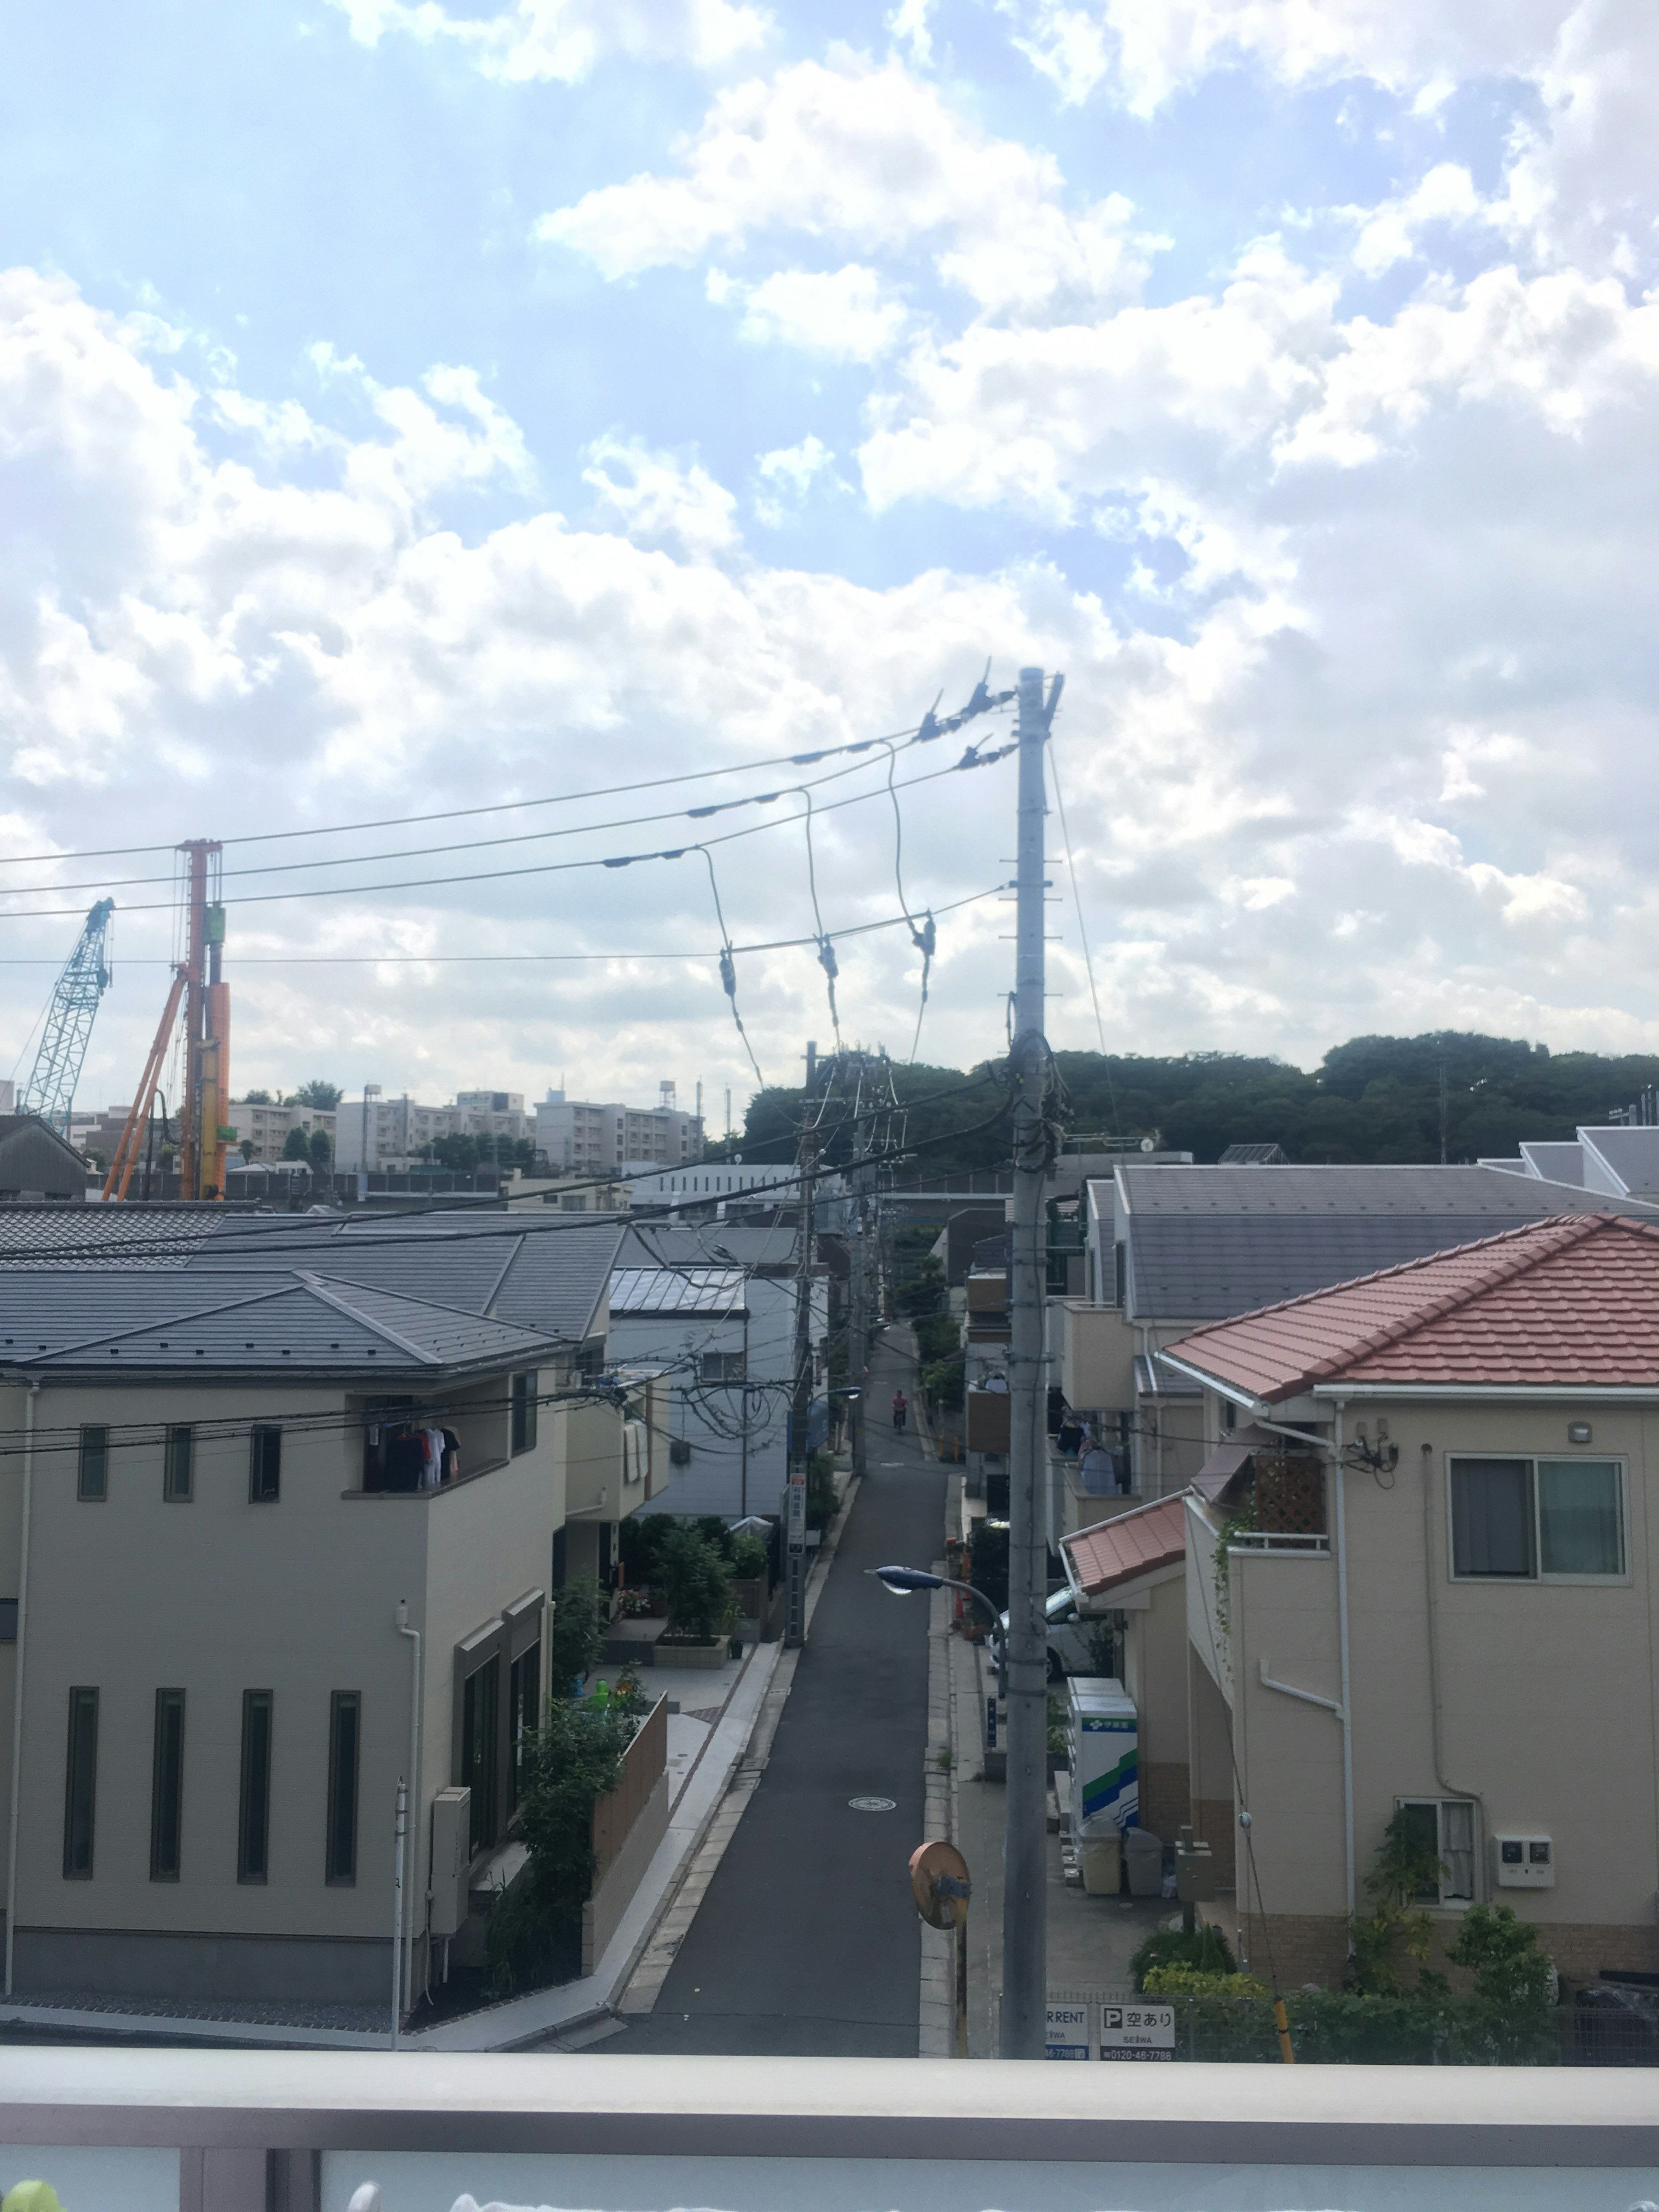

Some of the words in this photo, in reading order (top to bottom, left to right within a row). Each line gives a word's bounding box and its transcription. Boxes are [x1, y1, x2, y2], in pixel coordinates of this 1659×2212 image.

[1127, 2012, 1171, 2028] 空あり
[1111, 2050, 1171, 2061] 0120-46-7788
